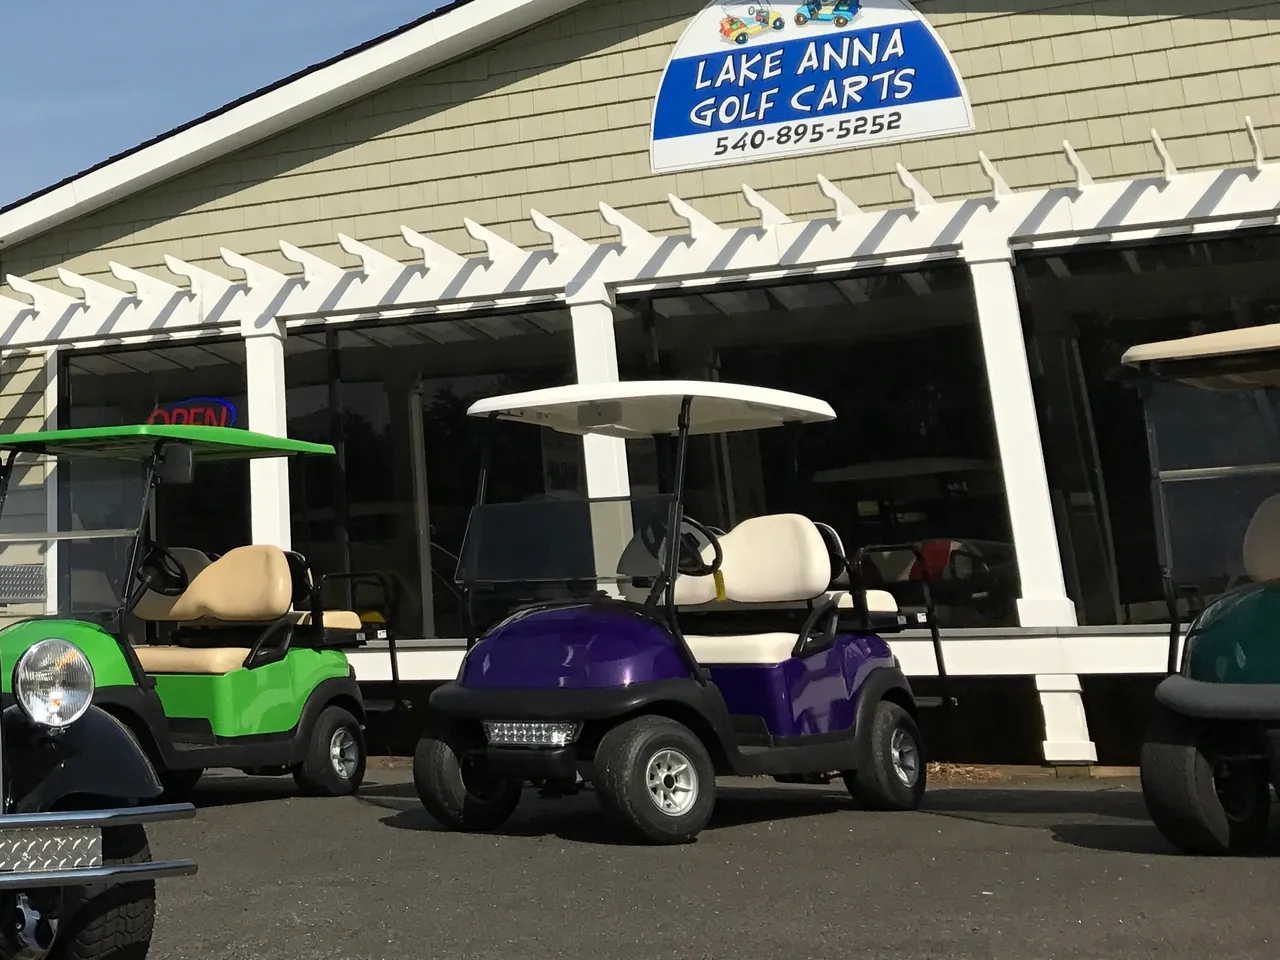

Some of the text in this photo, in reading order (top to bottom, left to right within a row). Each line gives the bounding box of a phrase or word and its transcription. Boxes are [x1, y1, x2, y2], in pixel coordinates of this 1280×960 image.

[694, 28, 906, 91] LAKE ANNA
[689, 67, 916, 128] GOLF CARTS
[714, 111, 903, 156] 540-895-5252
